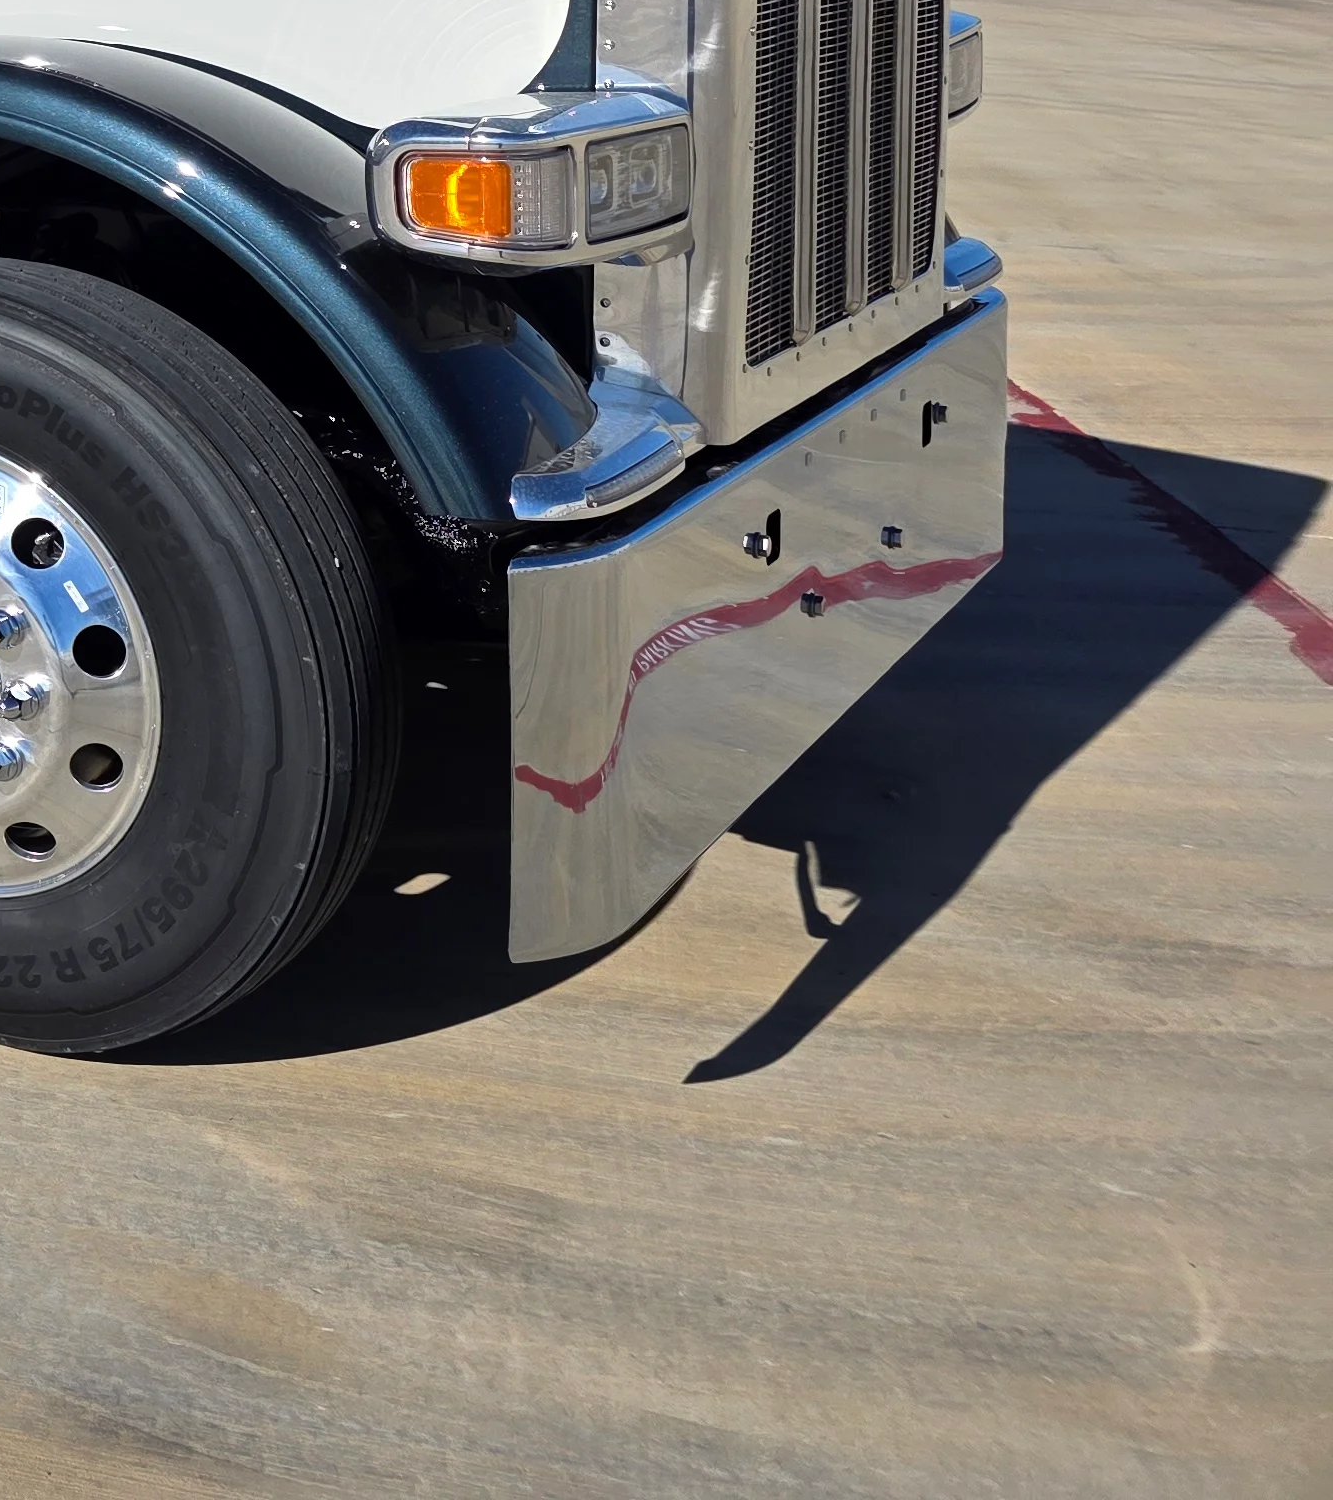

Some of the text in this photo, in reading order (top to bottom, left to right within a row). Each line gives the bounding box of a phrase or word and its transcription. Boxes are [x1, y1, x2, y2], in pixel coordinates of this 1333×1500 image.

[109, 466, 190, 561] HS3
[86, 848, 210, 974] 295/75
[49, 949, 88, 984] R
